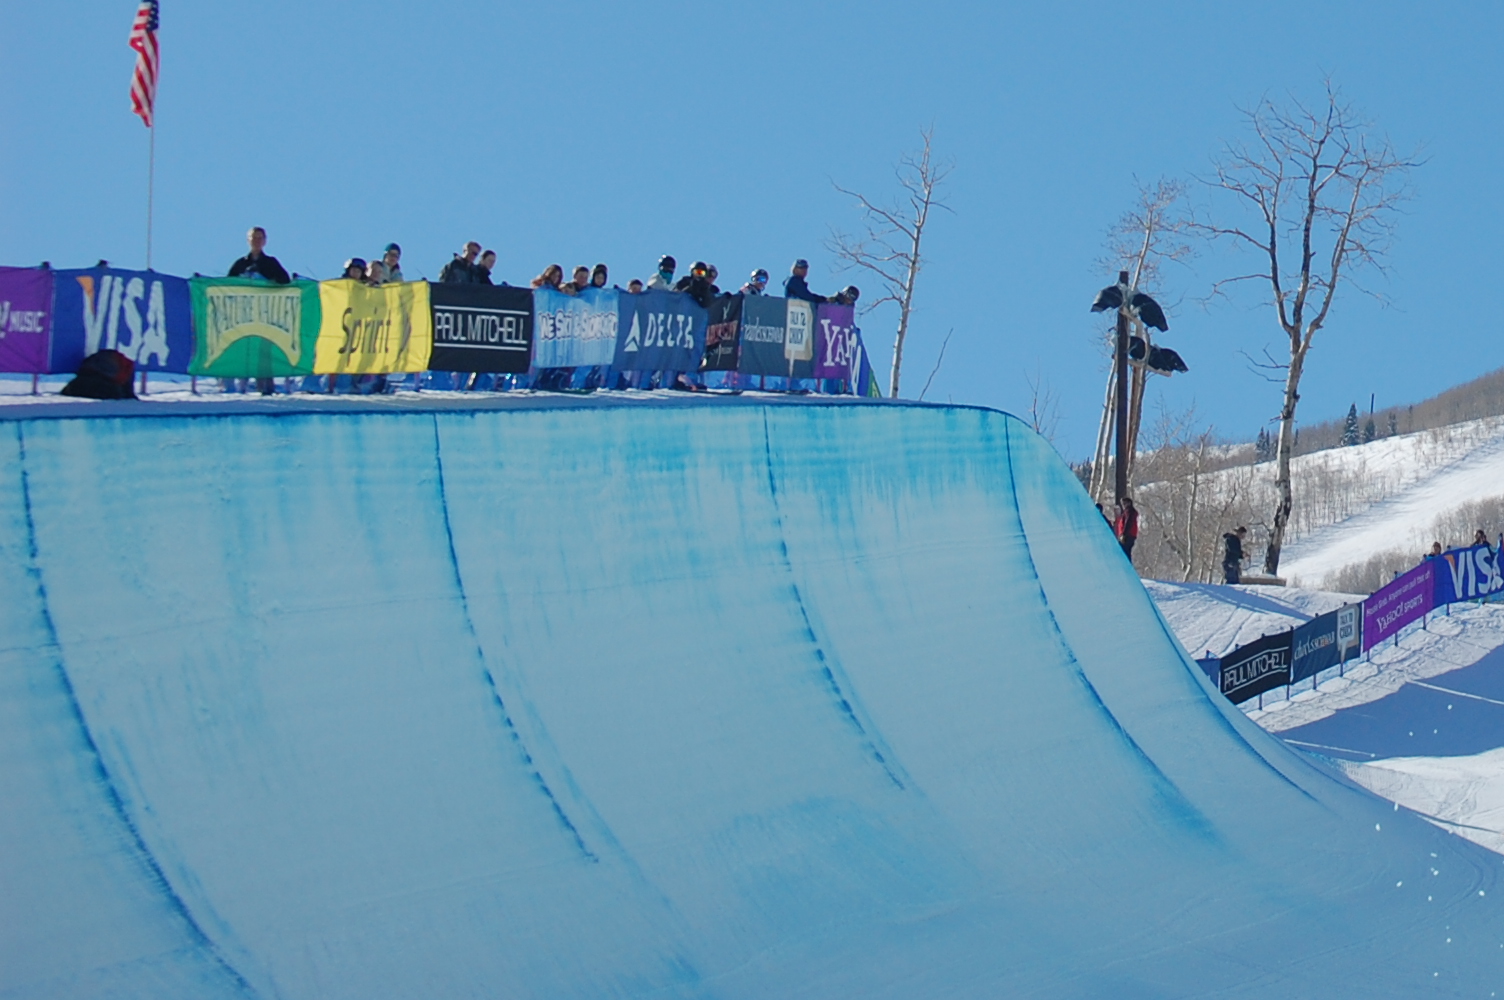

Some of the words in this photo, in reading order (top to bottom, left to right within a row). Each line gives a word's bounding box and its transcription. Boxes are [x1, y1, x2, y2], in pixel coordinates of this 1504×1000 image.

[76, 275, 170, 367] VISA
[339, 307, 391, 367] Sprint
[434, 312, 466, 341] PAUL
[467, 313, 528, 345] MITCHELL
[643, 313, 695, 350] DELTA
[1443, 546, 1504, 599] VISA
[1223, 666, 1247, 692] PAUL
[1246, 651, 1288, 679] MITCHELL
